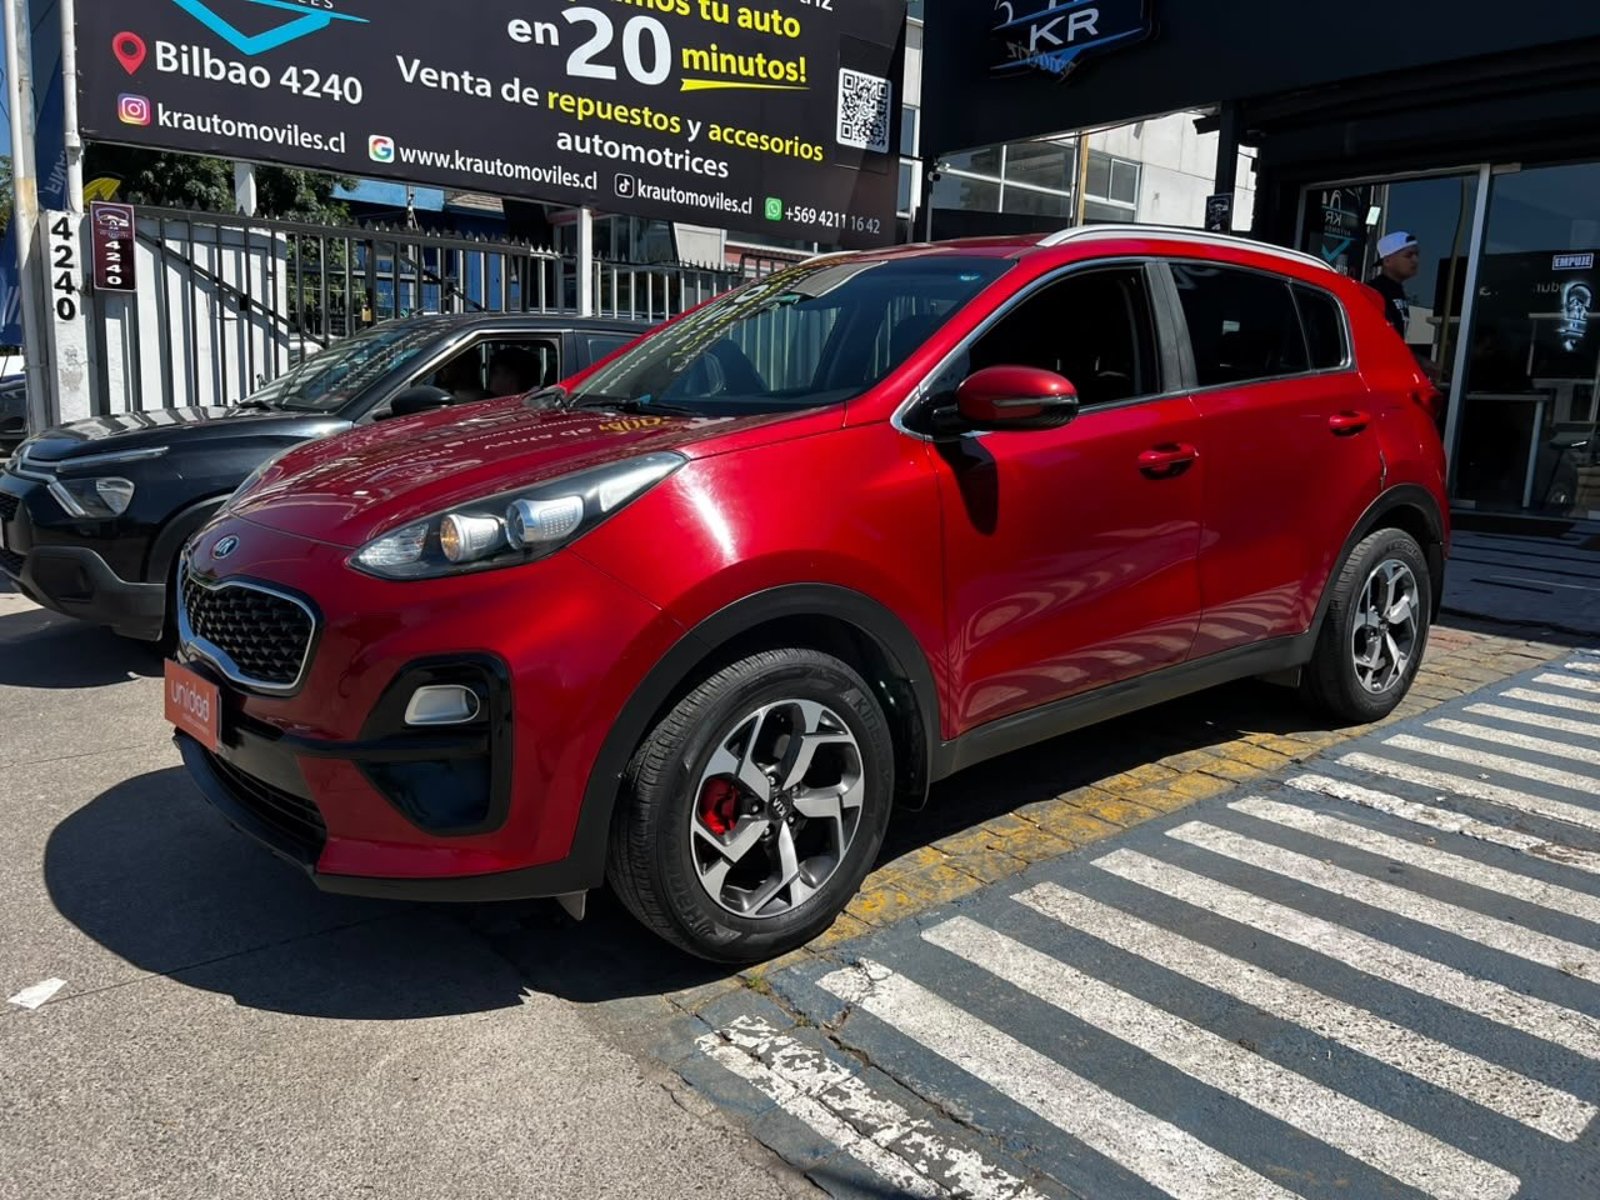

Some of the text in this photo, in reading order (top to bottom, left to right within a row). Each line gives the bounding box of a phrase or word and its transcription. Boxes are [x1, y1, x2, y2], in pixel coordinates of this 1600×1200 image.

[507, 6, 807, 86] en 20 minutos!
[737, 7, 801, 38] auto
[1030, 8, 1100, 51] KR
[155, 40, 363, 105] Bilbao 4240
[157, 102, 346, 154] krautomoviles.cl
[396, 54, 824, 162] Venta de repuestos y accesorios
[556, 131, 729, 178] automotrices
[399, 146, 881, 234] www.krautomoviles.cl krautomoviles.cl +569 4211 16 42
[51, 217, 77, 321] 4240
[104, 240, 122, 285] 4240
